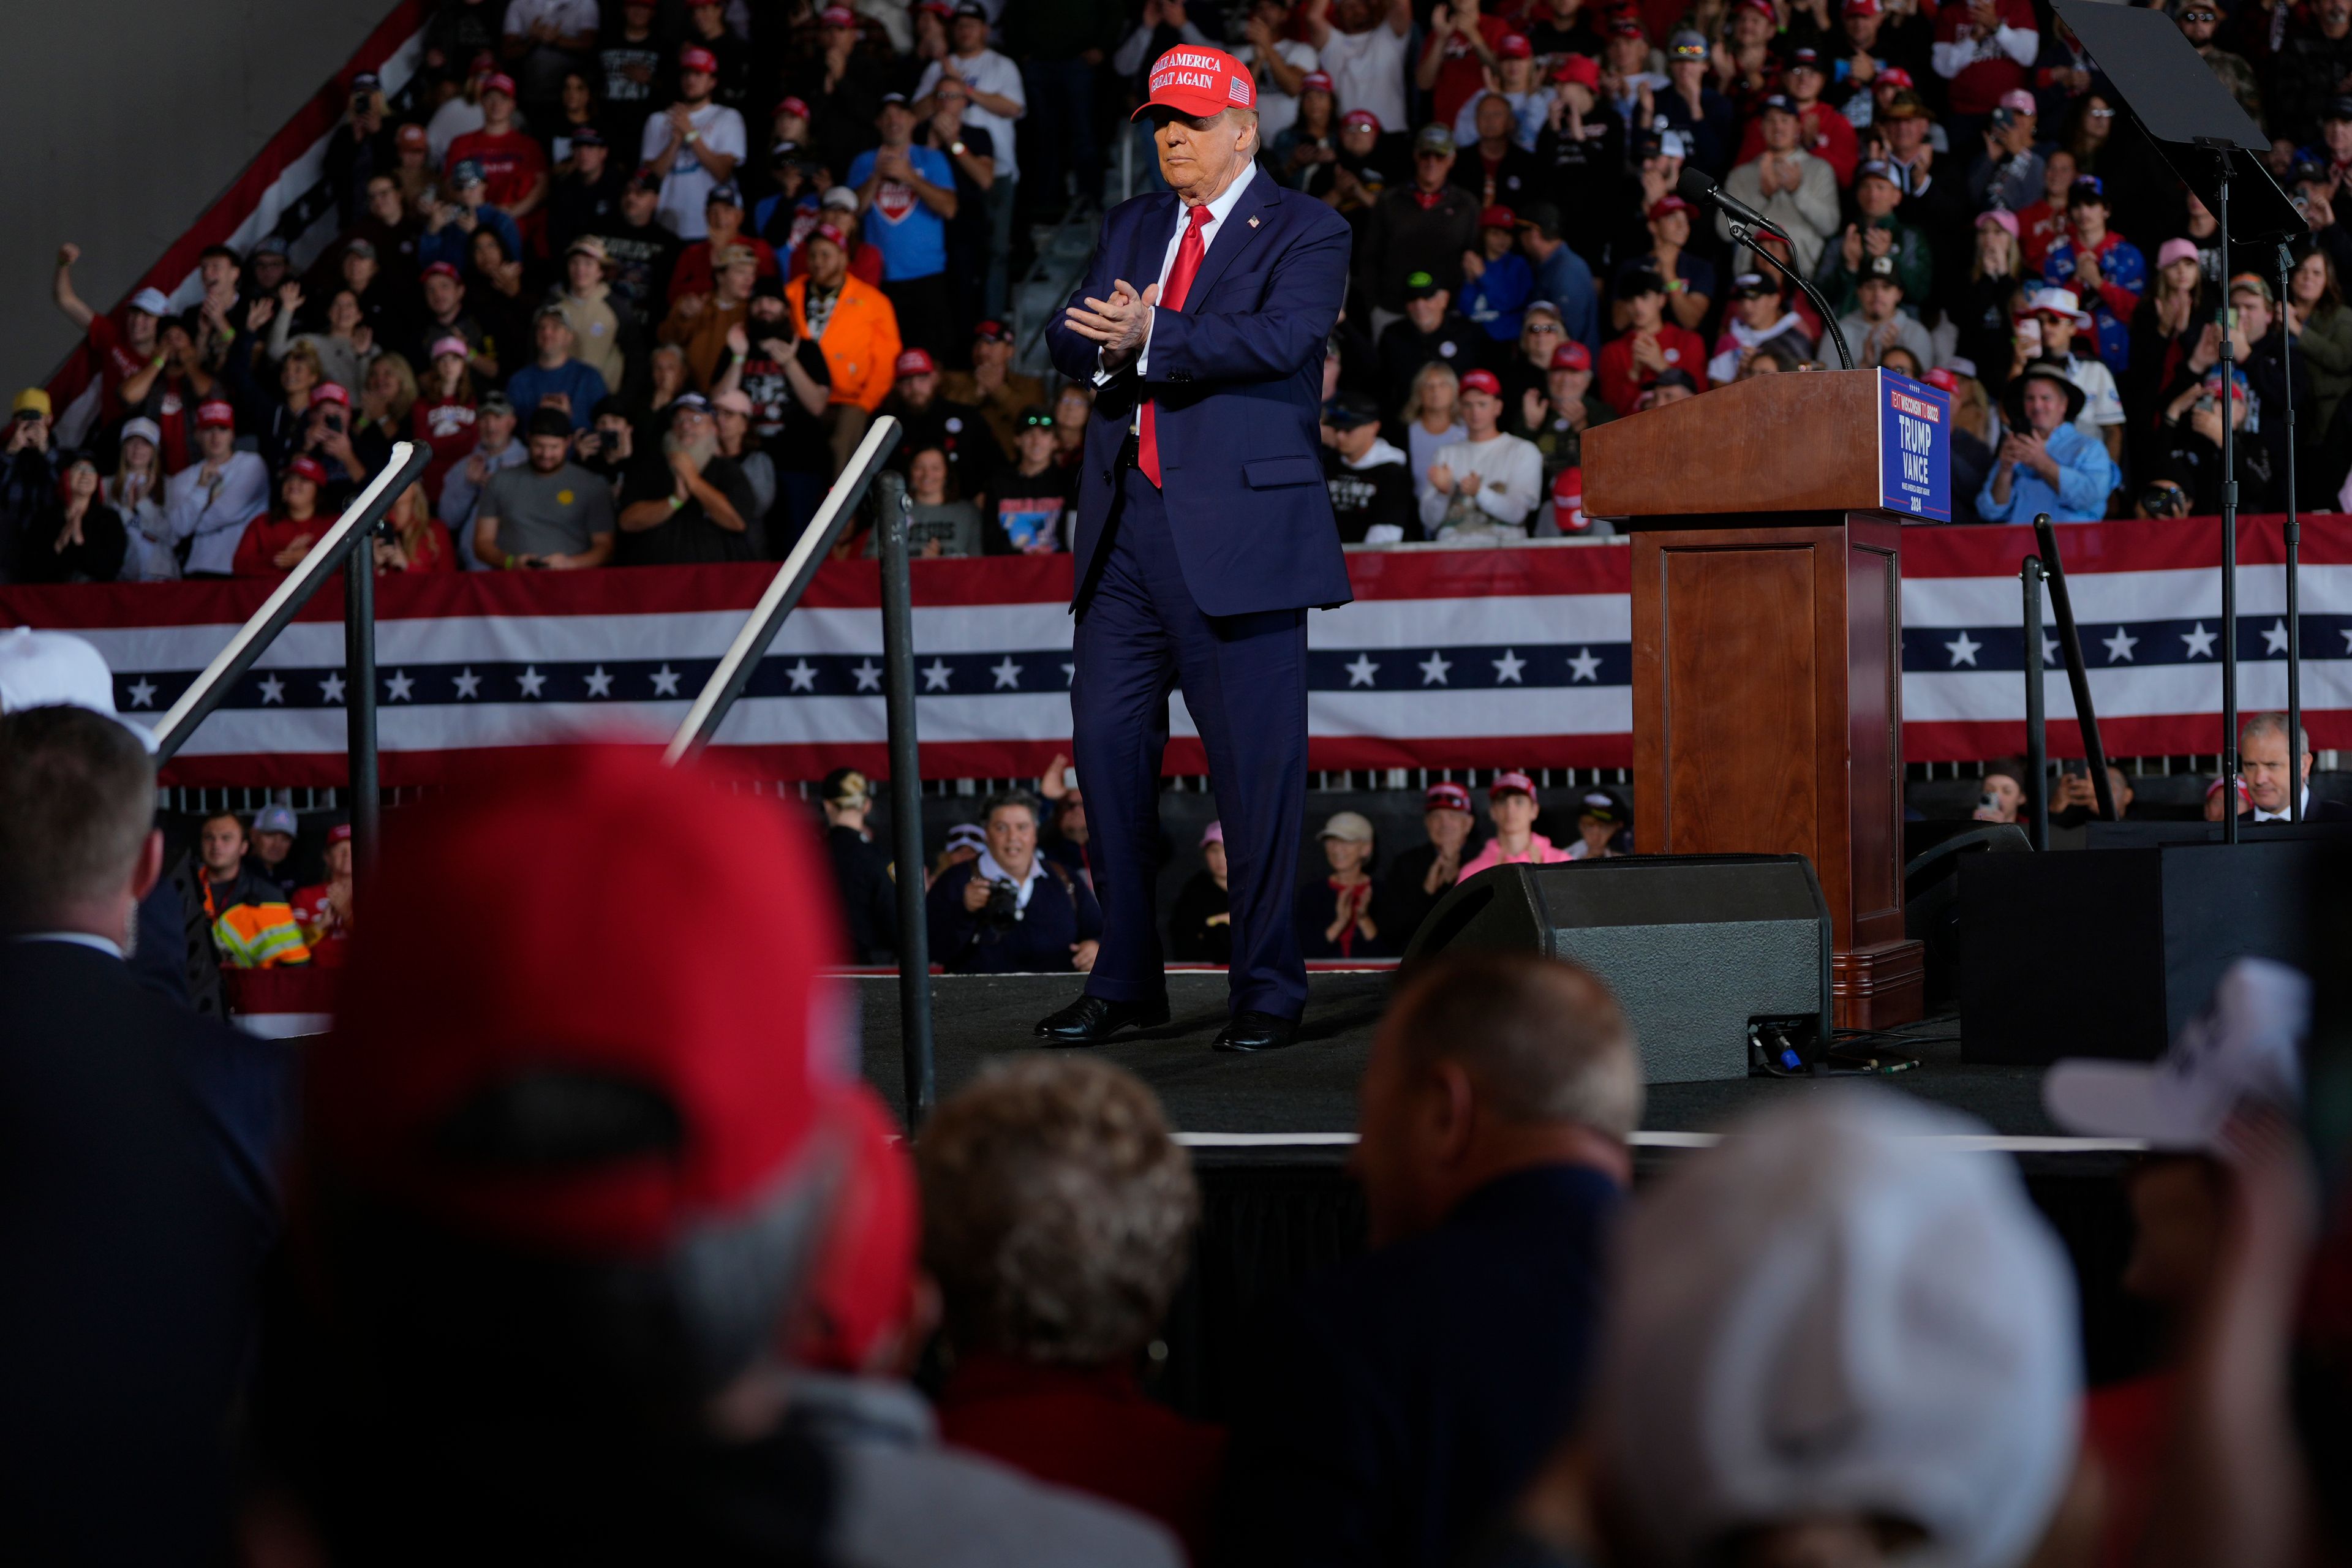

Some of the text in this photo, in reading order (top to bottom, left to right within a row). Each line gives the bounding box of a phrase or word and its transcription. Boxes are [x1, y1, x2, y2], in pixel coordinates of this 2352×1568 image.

[1150, 53, 1221, 77] MAKE AMERICA
[1152, 72, 1213, 92] GREAT AGAIN
[1891, 391, 1939, 422] TEXT WISCONSIN TO 88022
[1899, 414, 1931, 456] TRUMP
[1902, 451, 1928, 484] VANCE
[1911, 496, 1921, 513] 2024
